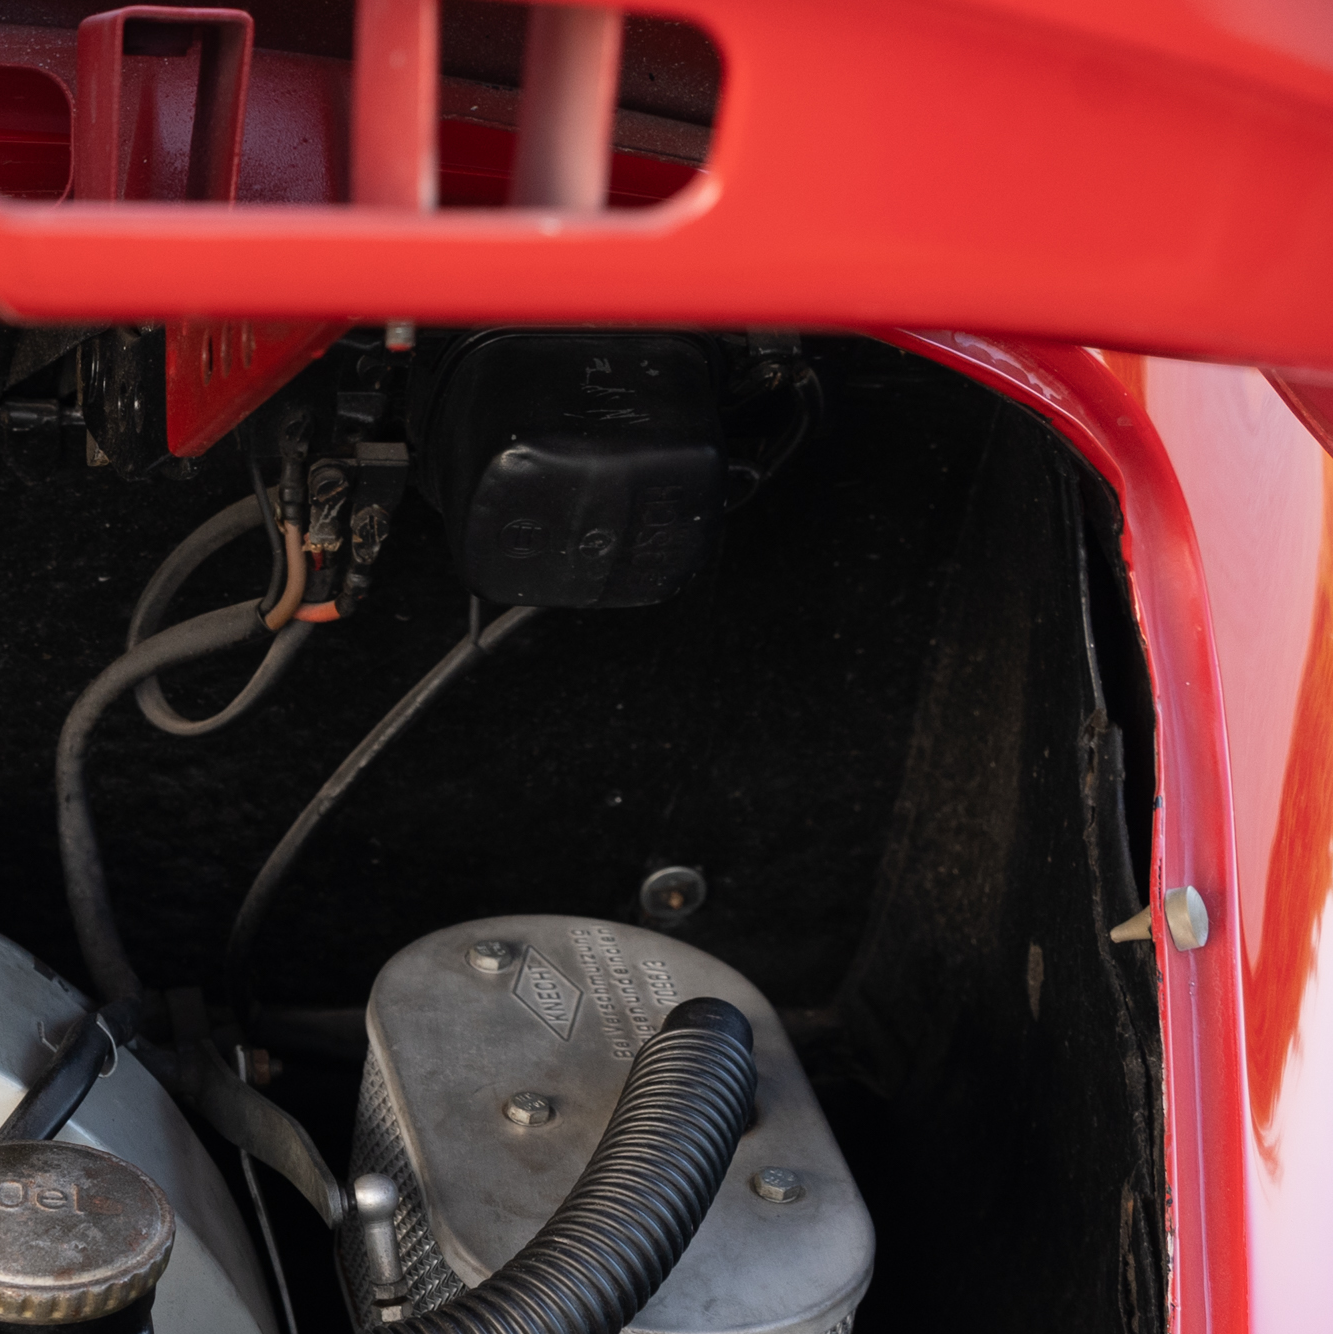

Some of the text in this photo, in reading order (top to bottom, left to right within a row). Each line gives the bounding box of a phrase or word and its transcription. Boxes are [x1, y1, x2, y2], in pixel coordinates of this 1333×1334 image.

[527, 963, 569, 1024] KNECHT
[570, 928, 635, 1061] Bei Verschmutzung
